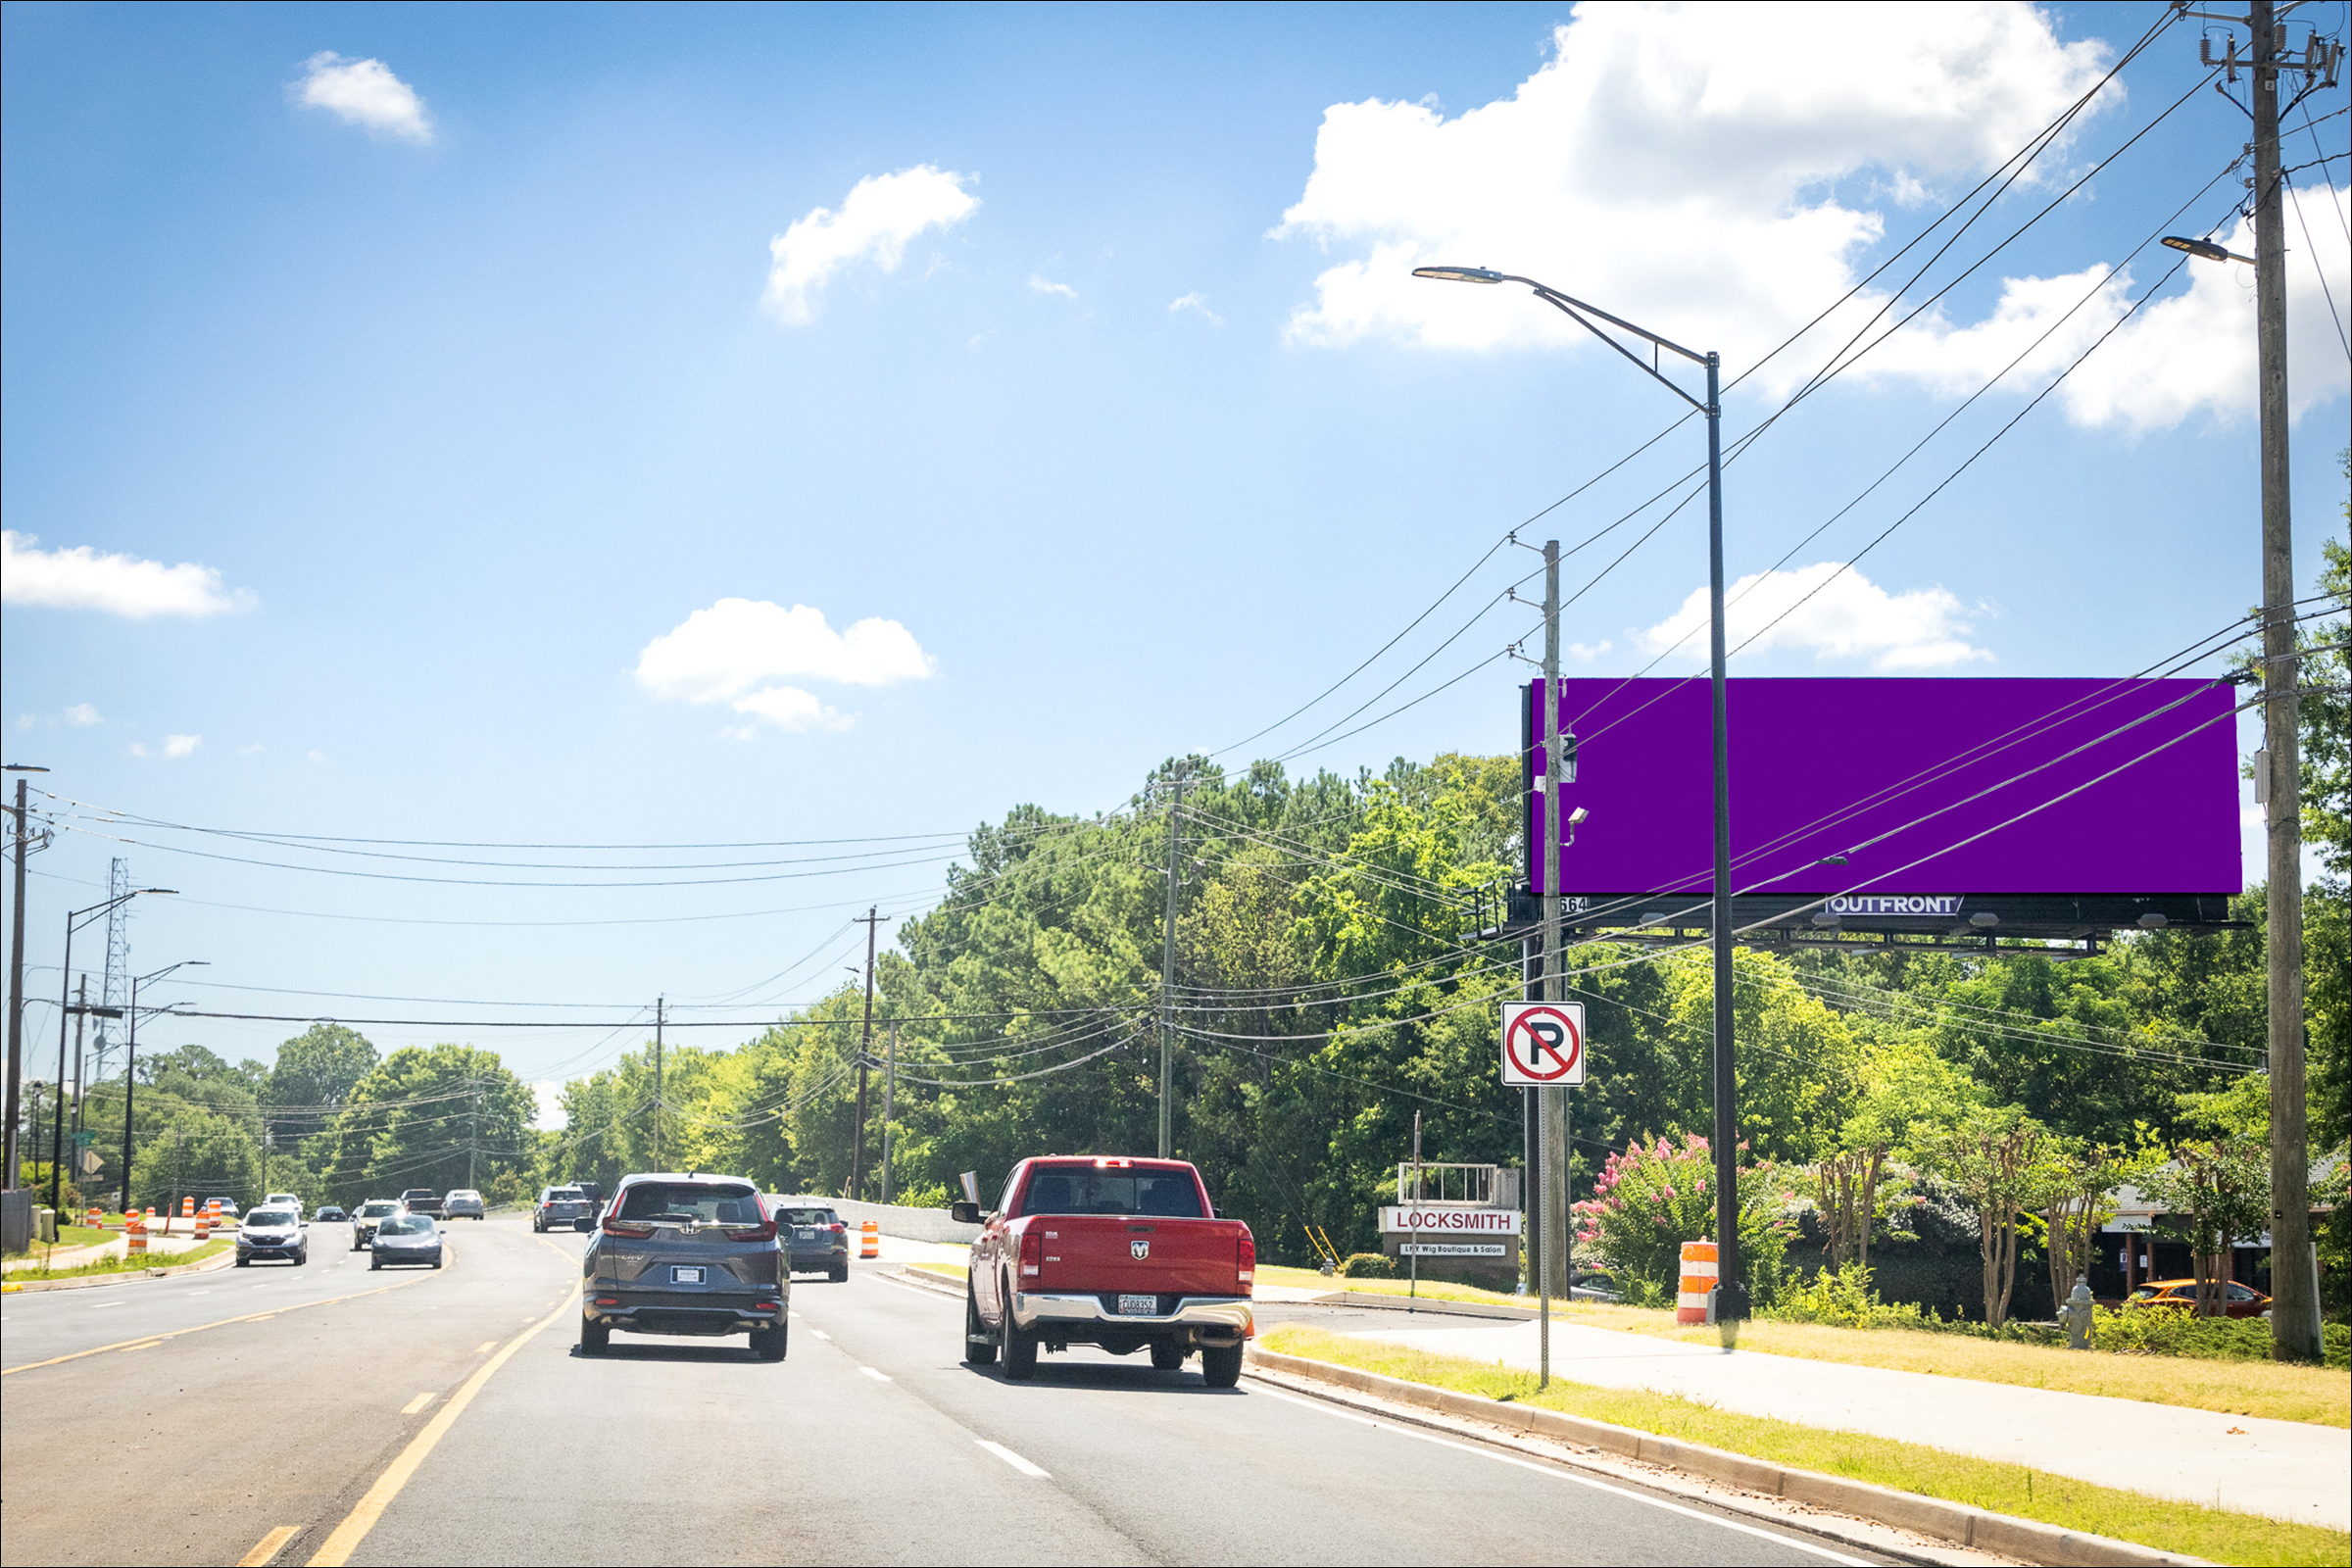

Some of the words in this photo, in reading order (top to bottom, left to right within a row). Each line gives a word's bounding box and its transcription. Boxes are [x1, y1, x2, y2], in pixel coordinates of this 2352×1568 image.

[1831, 896, 1956, 912] OUTFRONT
[1397, 1212, 1510, 1230] LOCKSMITH
[1421, 1246, 1437, 1254] Wig
[1438, 1246, 1471, 1254] Boutique
